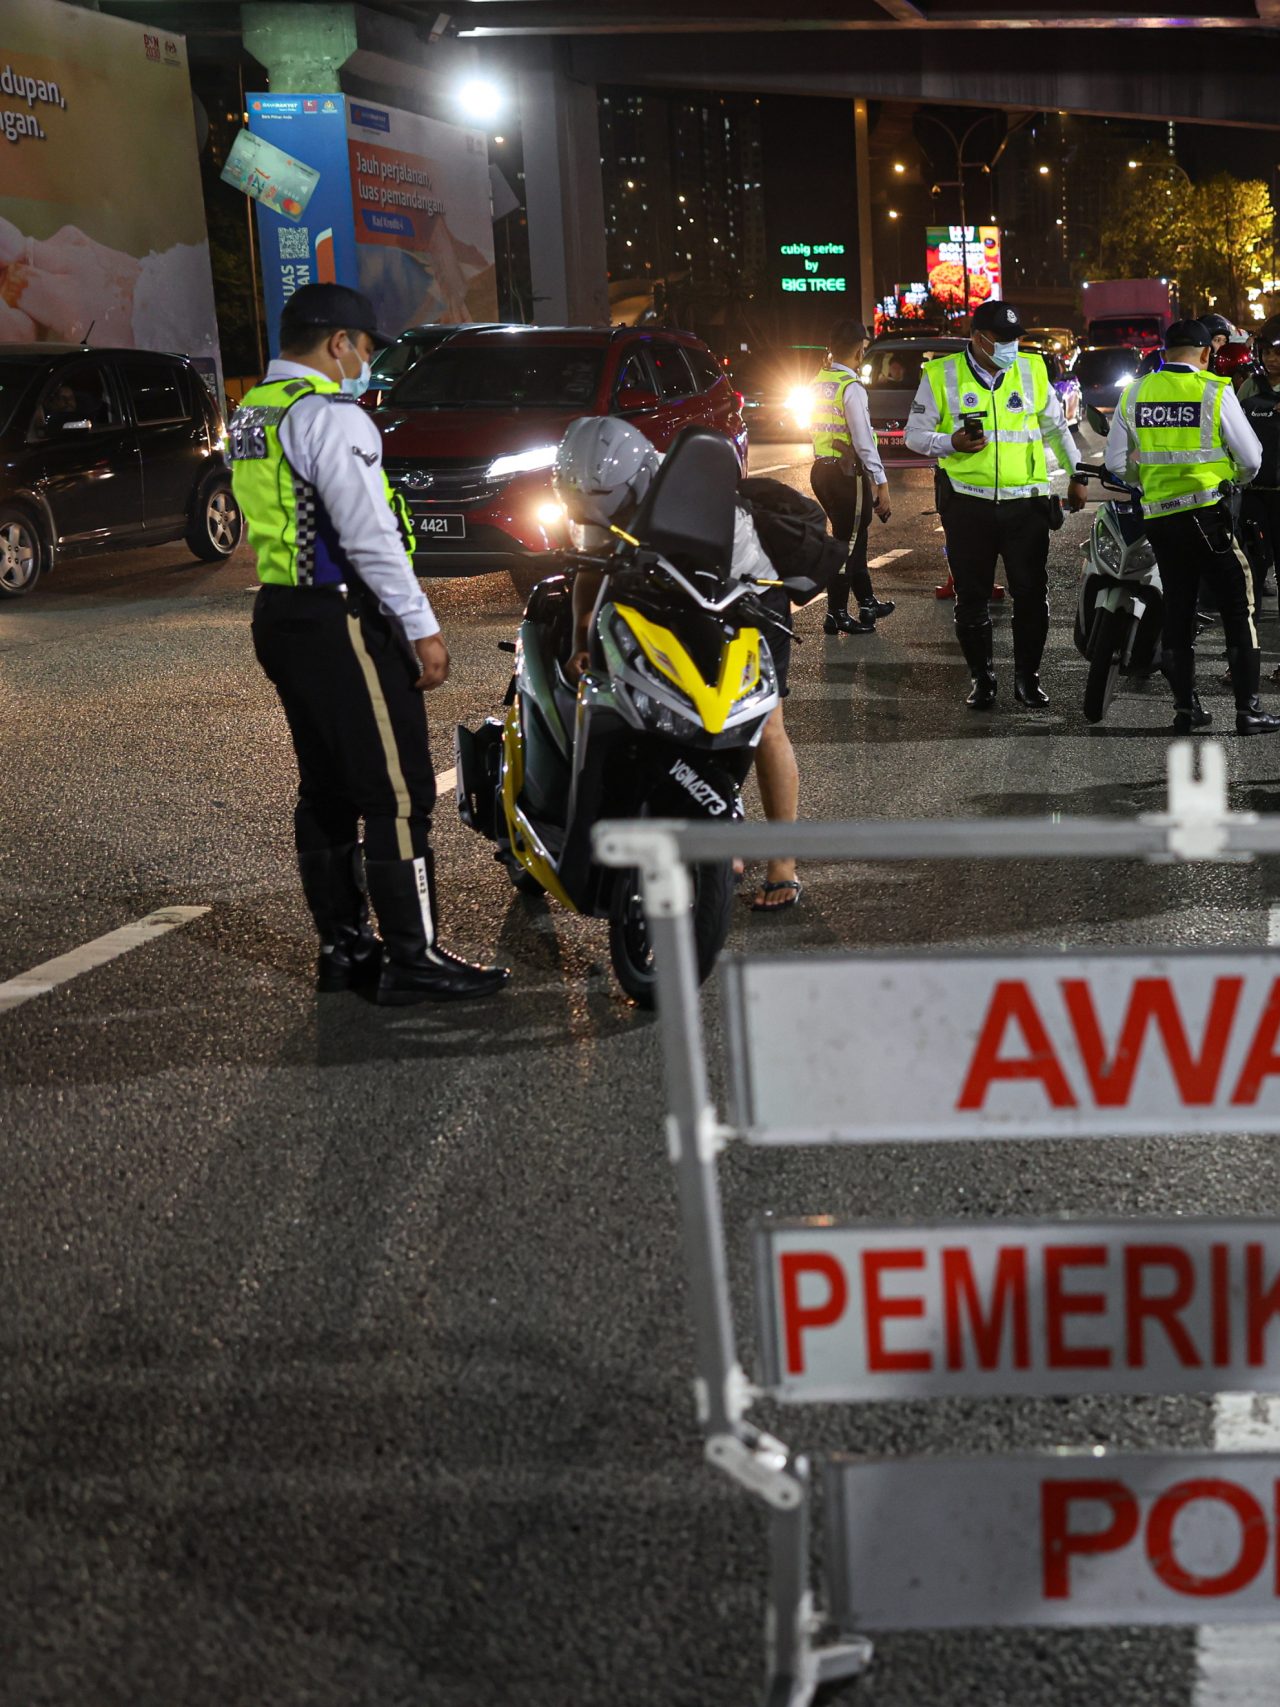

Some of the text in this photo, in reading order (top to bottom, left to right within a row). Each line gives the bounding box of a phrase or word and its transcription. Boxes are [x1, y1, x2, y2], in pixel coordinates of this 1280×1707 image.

[356, 152, 380, 176] Jauh
[358, 178, 380, 201] luas
[780, 242, 845, 257] cubig series
[804, 259, 819, 273] by
[781, 278, 846, 291] BIG TREE
[1140, 406, 1195, 422] POLIS
[420, 518, 448, 532] 4421
[669, 758, 728, 816] VGW4273
